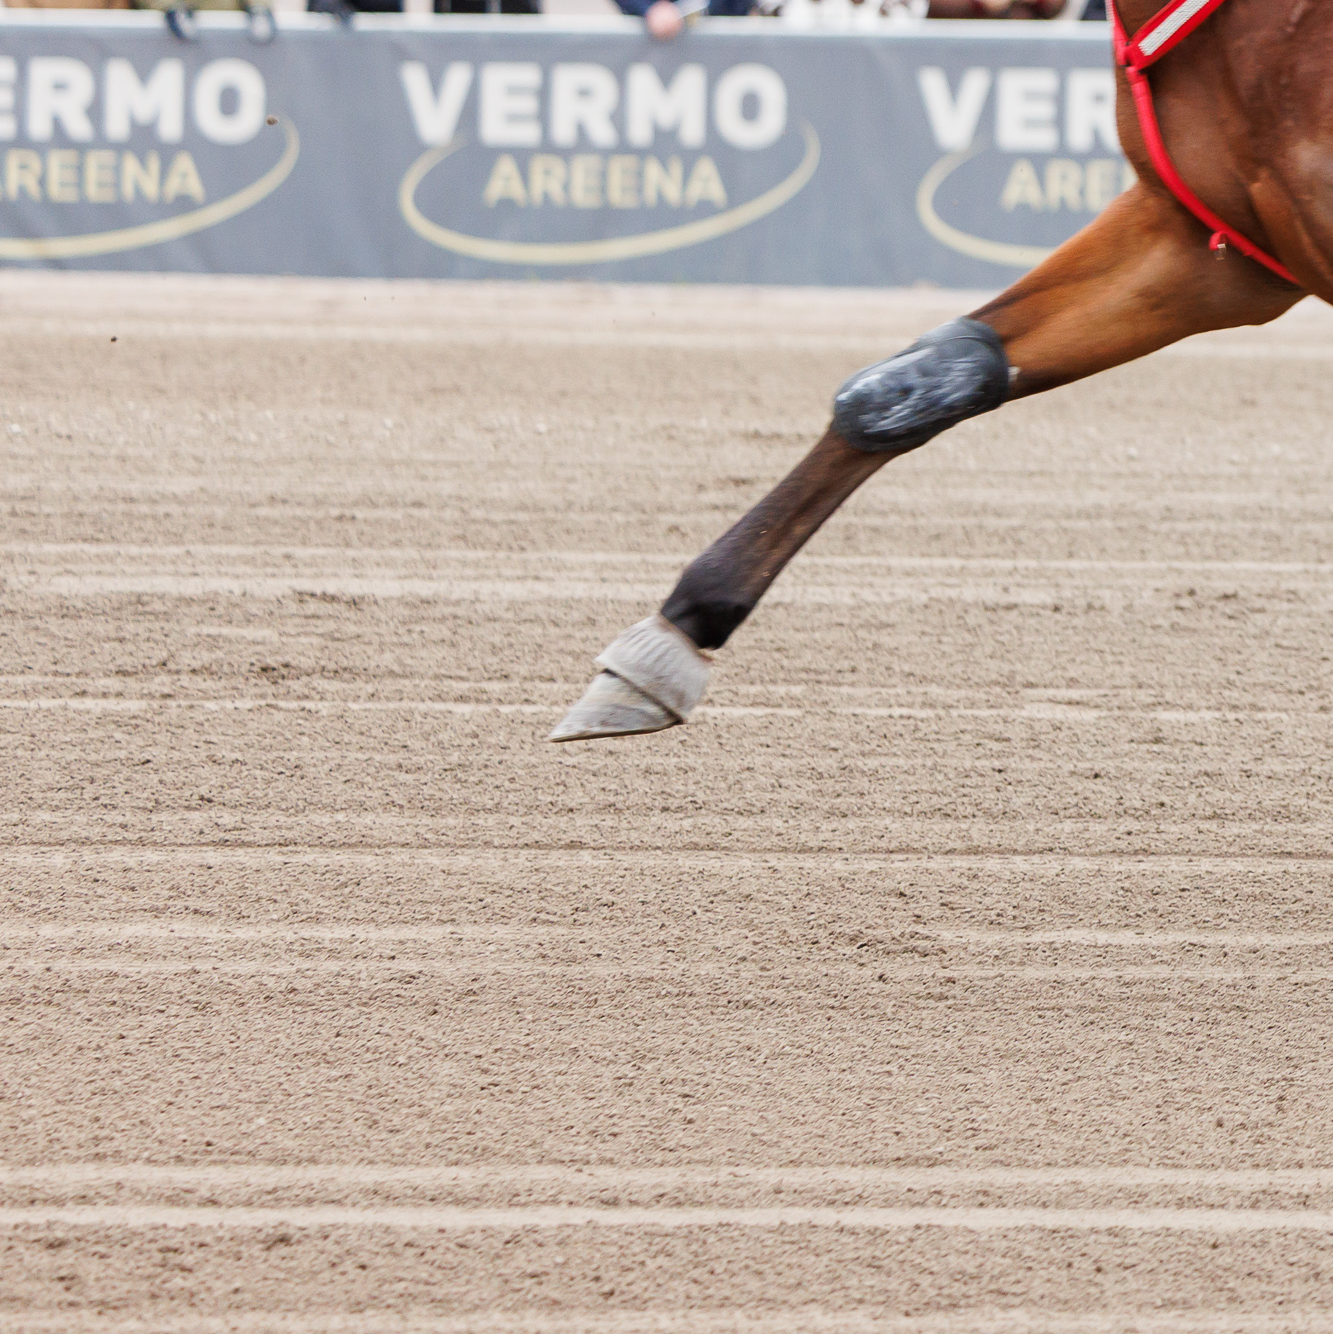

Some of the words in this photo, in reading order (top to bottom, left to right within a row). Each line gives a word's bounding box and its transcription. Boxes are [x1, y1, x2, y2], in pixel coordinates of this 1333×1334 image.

[0, 55, 267, 146] RMO
[402, 60, 788, 151] VERMO
[484, 153, 727, 209] AREENA
